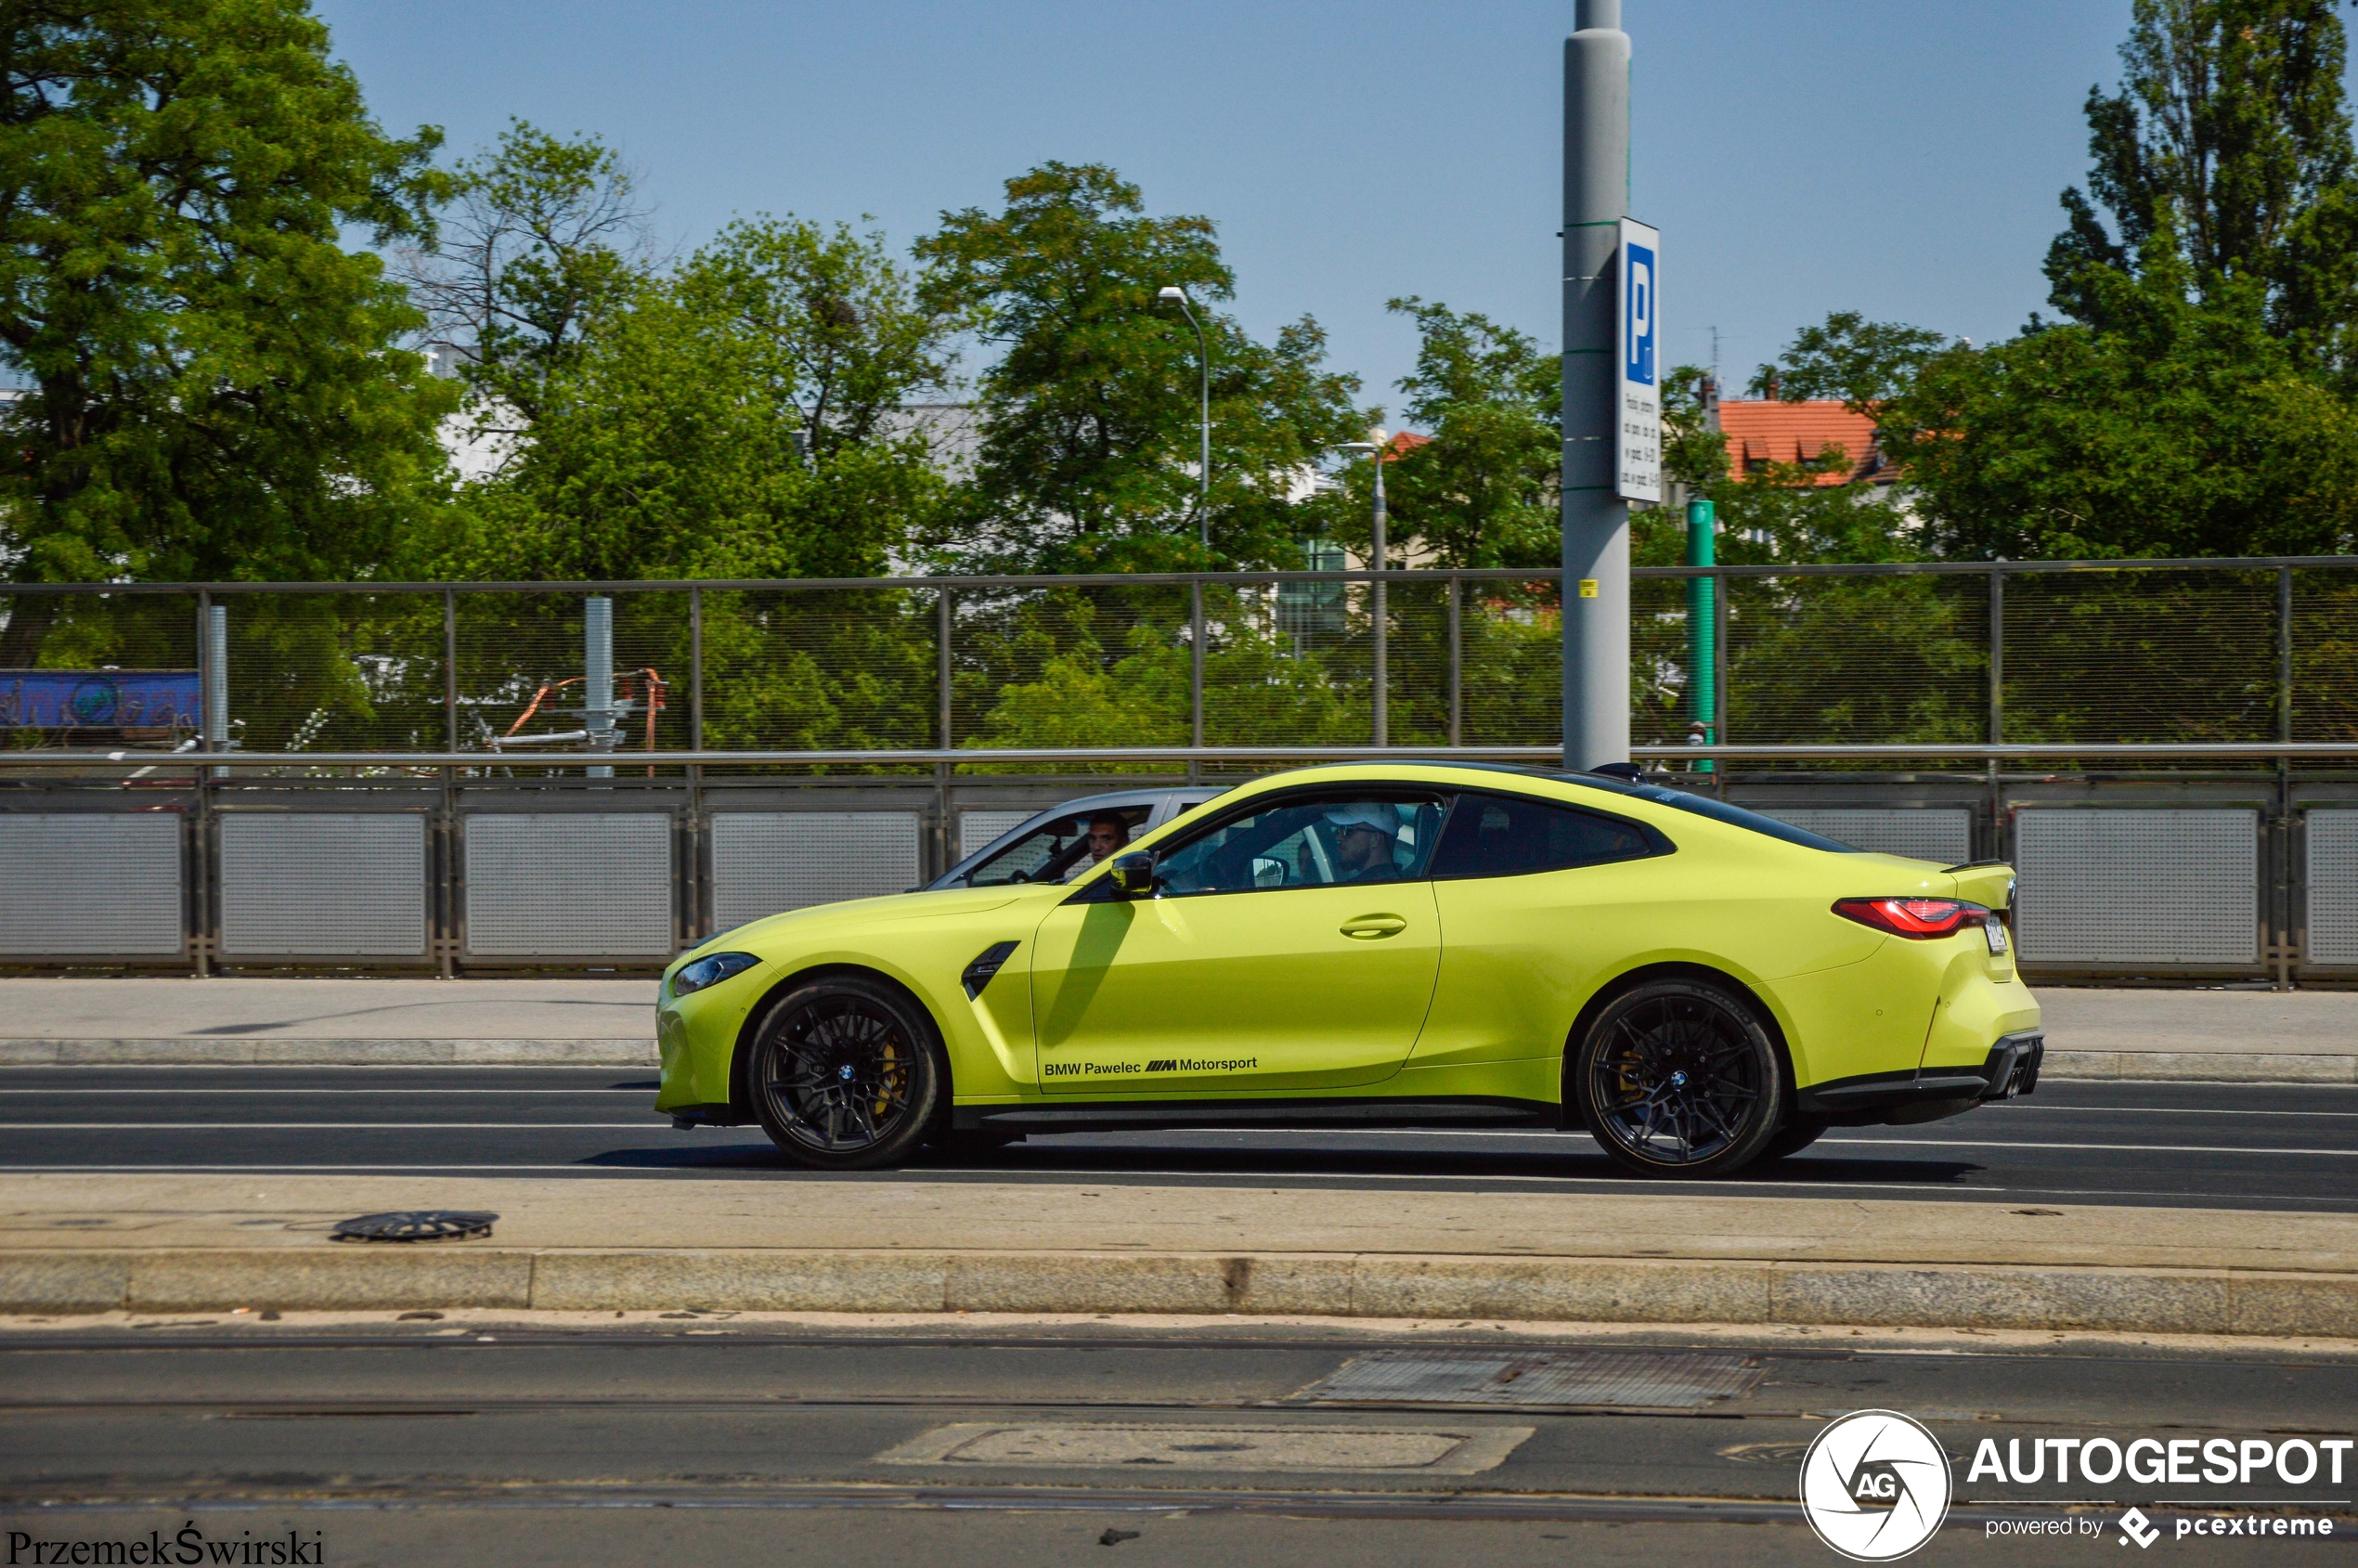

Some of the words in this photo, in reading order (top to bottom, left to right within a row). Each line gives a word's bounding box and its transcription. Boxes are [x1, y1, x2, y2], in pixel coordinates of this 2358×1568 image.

[1631, 261, 1650, 364] P
[1044, 1063, 1081, 1075] BMW
[1085, 1061, 1141, 1074] Pawelec
[1180, 1056, 1257, 1071] Motorsport
